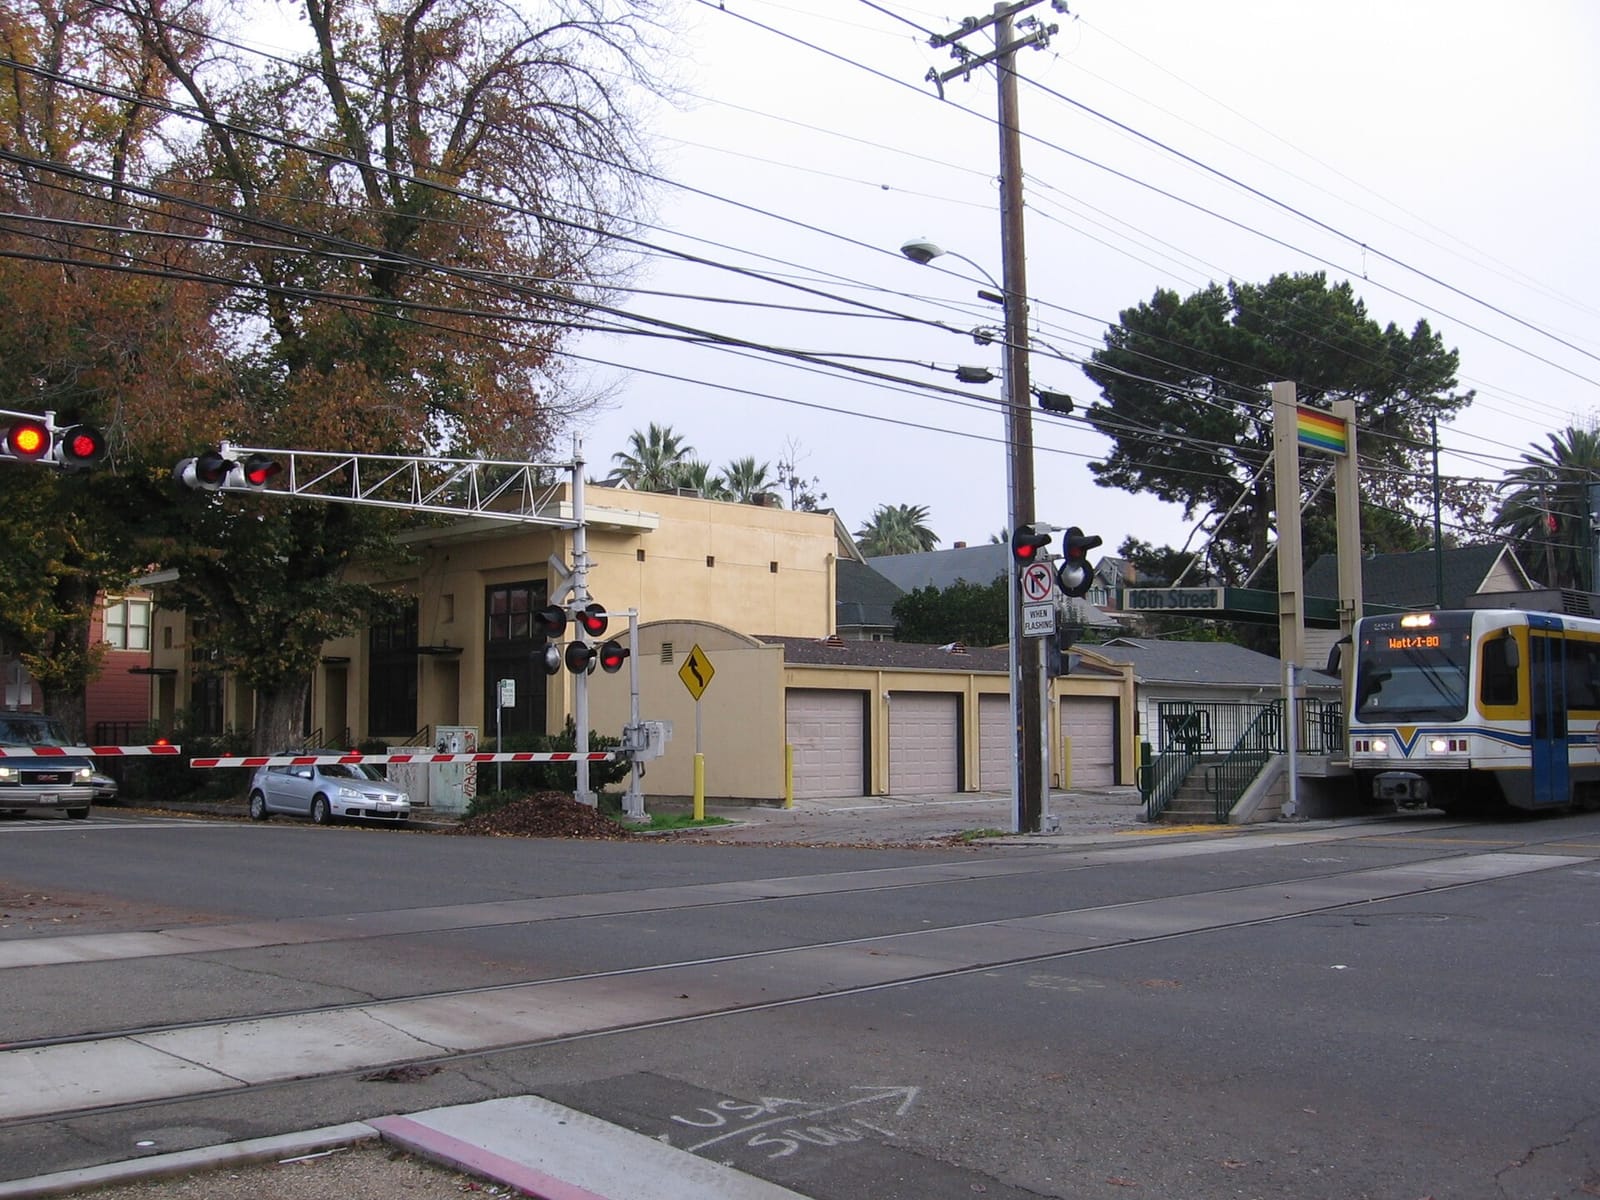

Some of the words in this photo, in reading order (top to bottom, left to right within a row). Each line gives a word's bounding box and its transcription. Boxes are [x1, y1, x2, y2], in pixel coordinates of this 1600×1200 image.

[1168, 589, 1218, 609] Street
[1029, 609, 1048, 619] WHEN
[1025, 620, 1053, 631] FLASHING
[1389, 636, 1439, 649] Watt/I-80
[670, 1096, 810, 1128] USA
